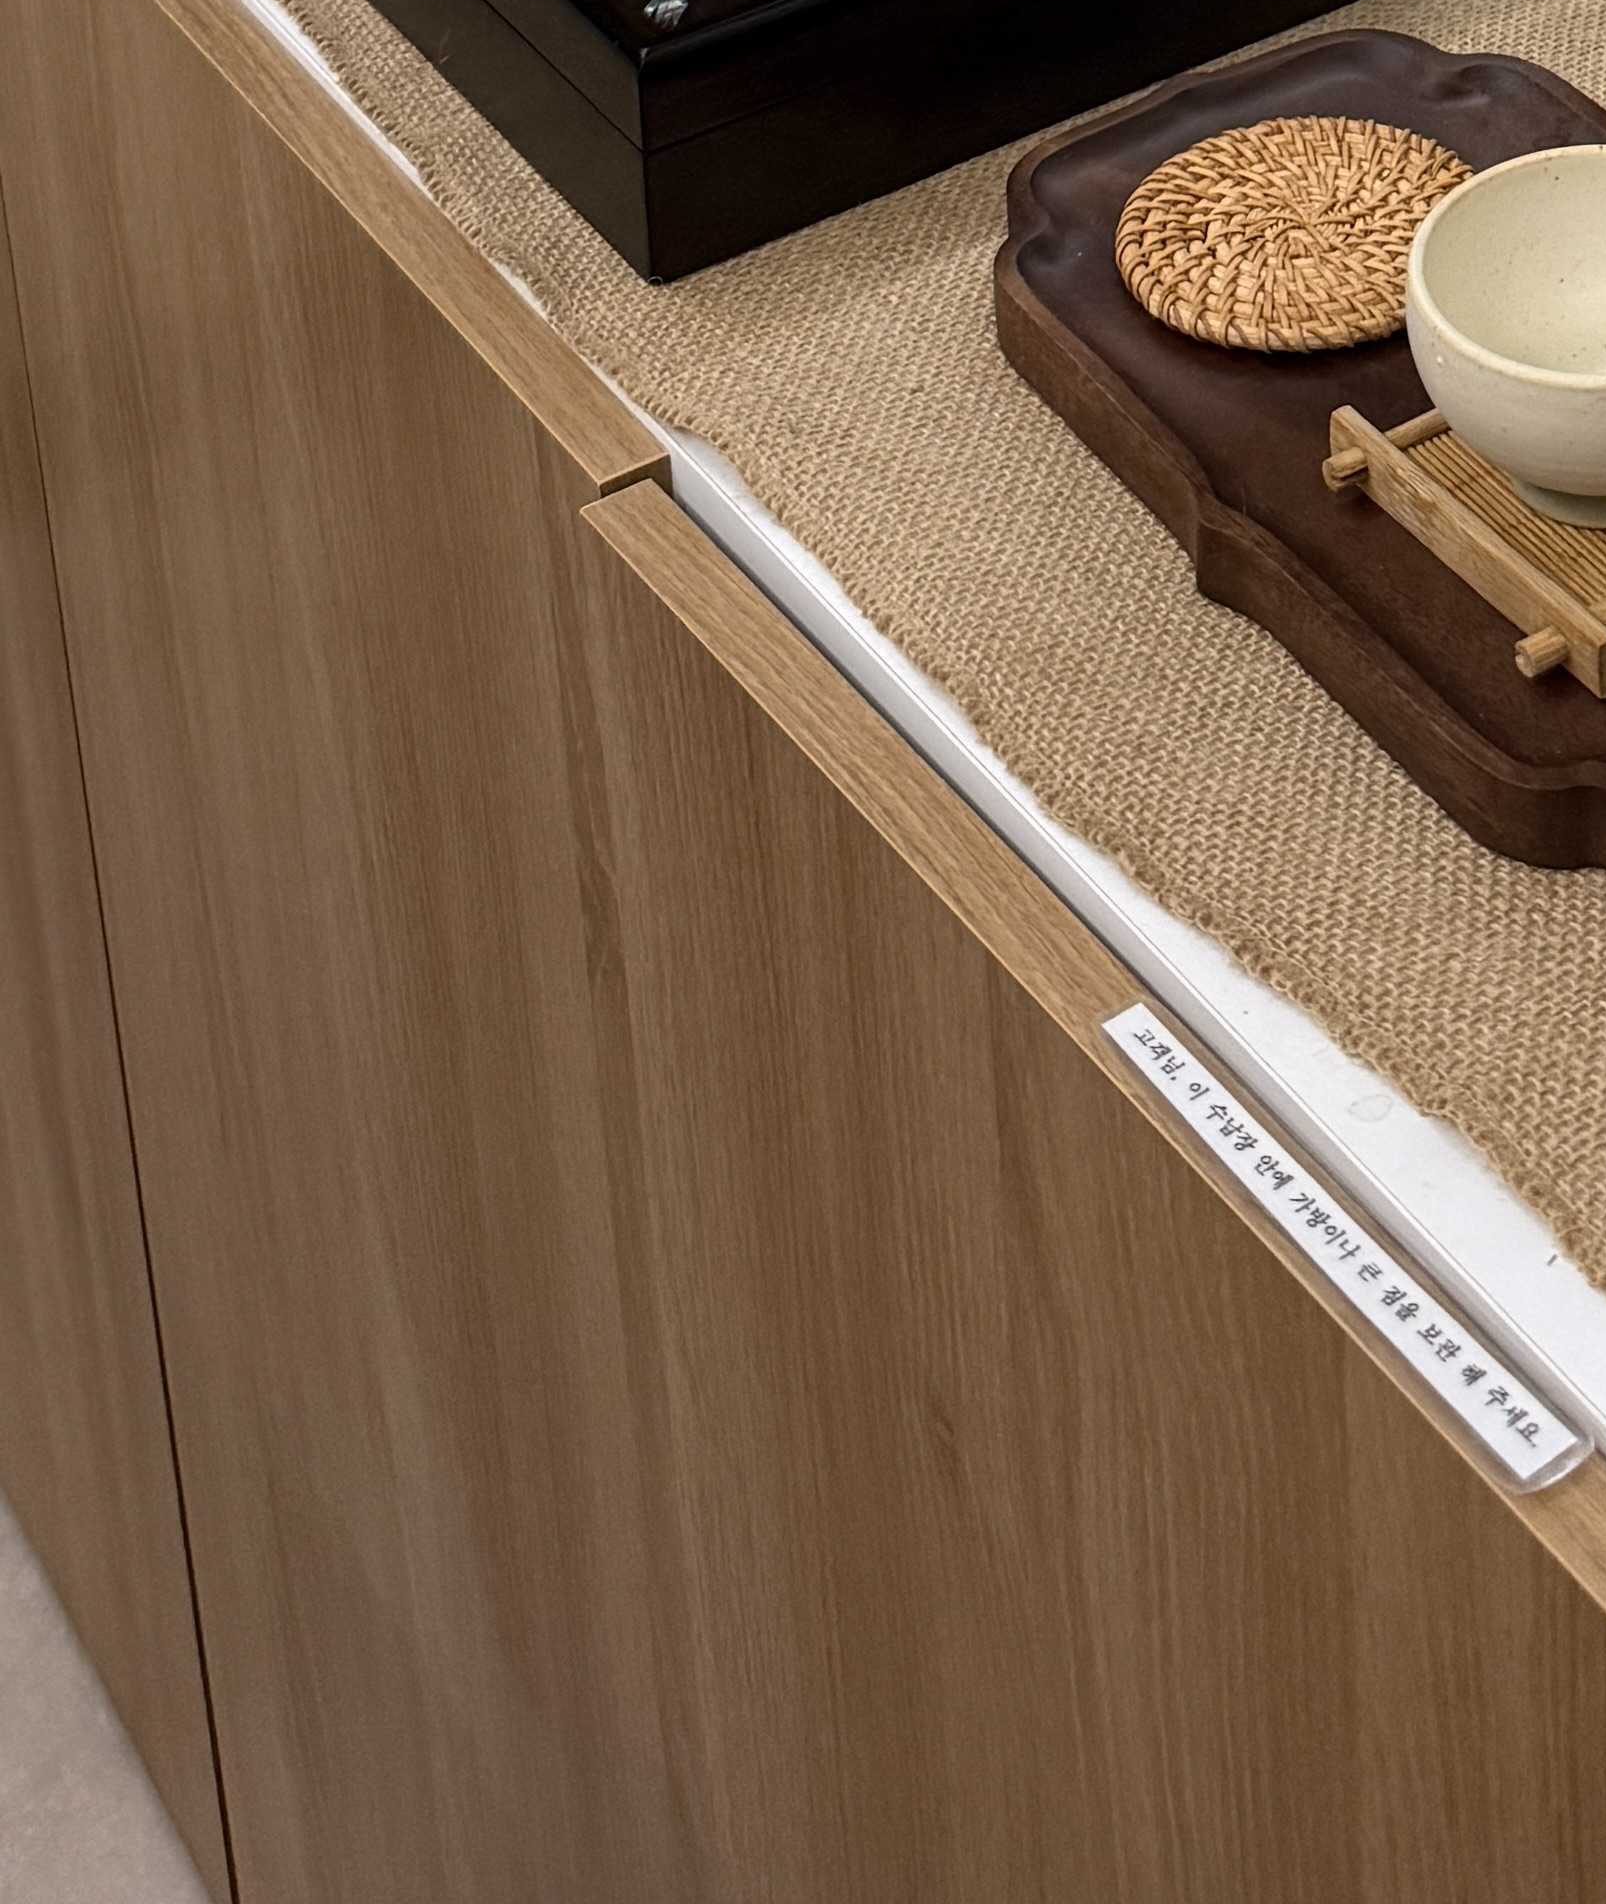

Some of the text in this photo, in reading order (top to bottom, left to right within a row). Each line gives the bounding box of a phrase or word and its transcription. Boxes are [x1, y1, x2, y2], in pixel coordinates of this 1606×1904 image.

[1133, 1029, 1538, 1447] 고객님, 이 수납장 안에 가방이나 큰 짐을 보관 해 주세요.
